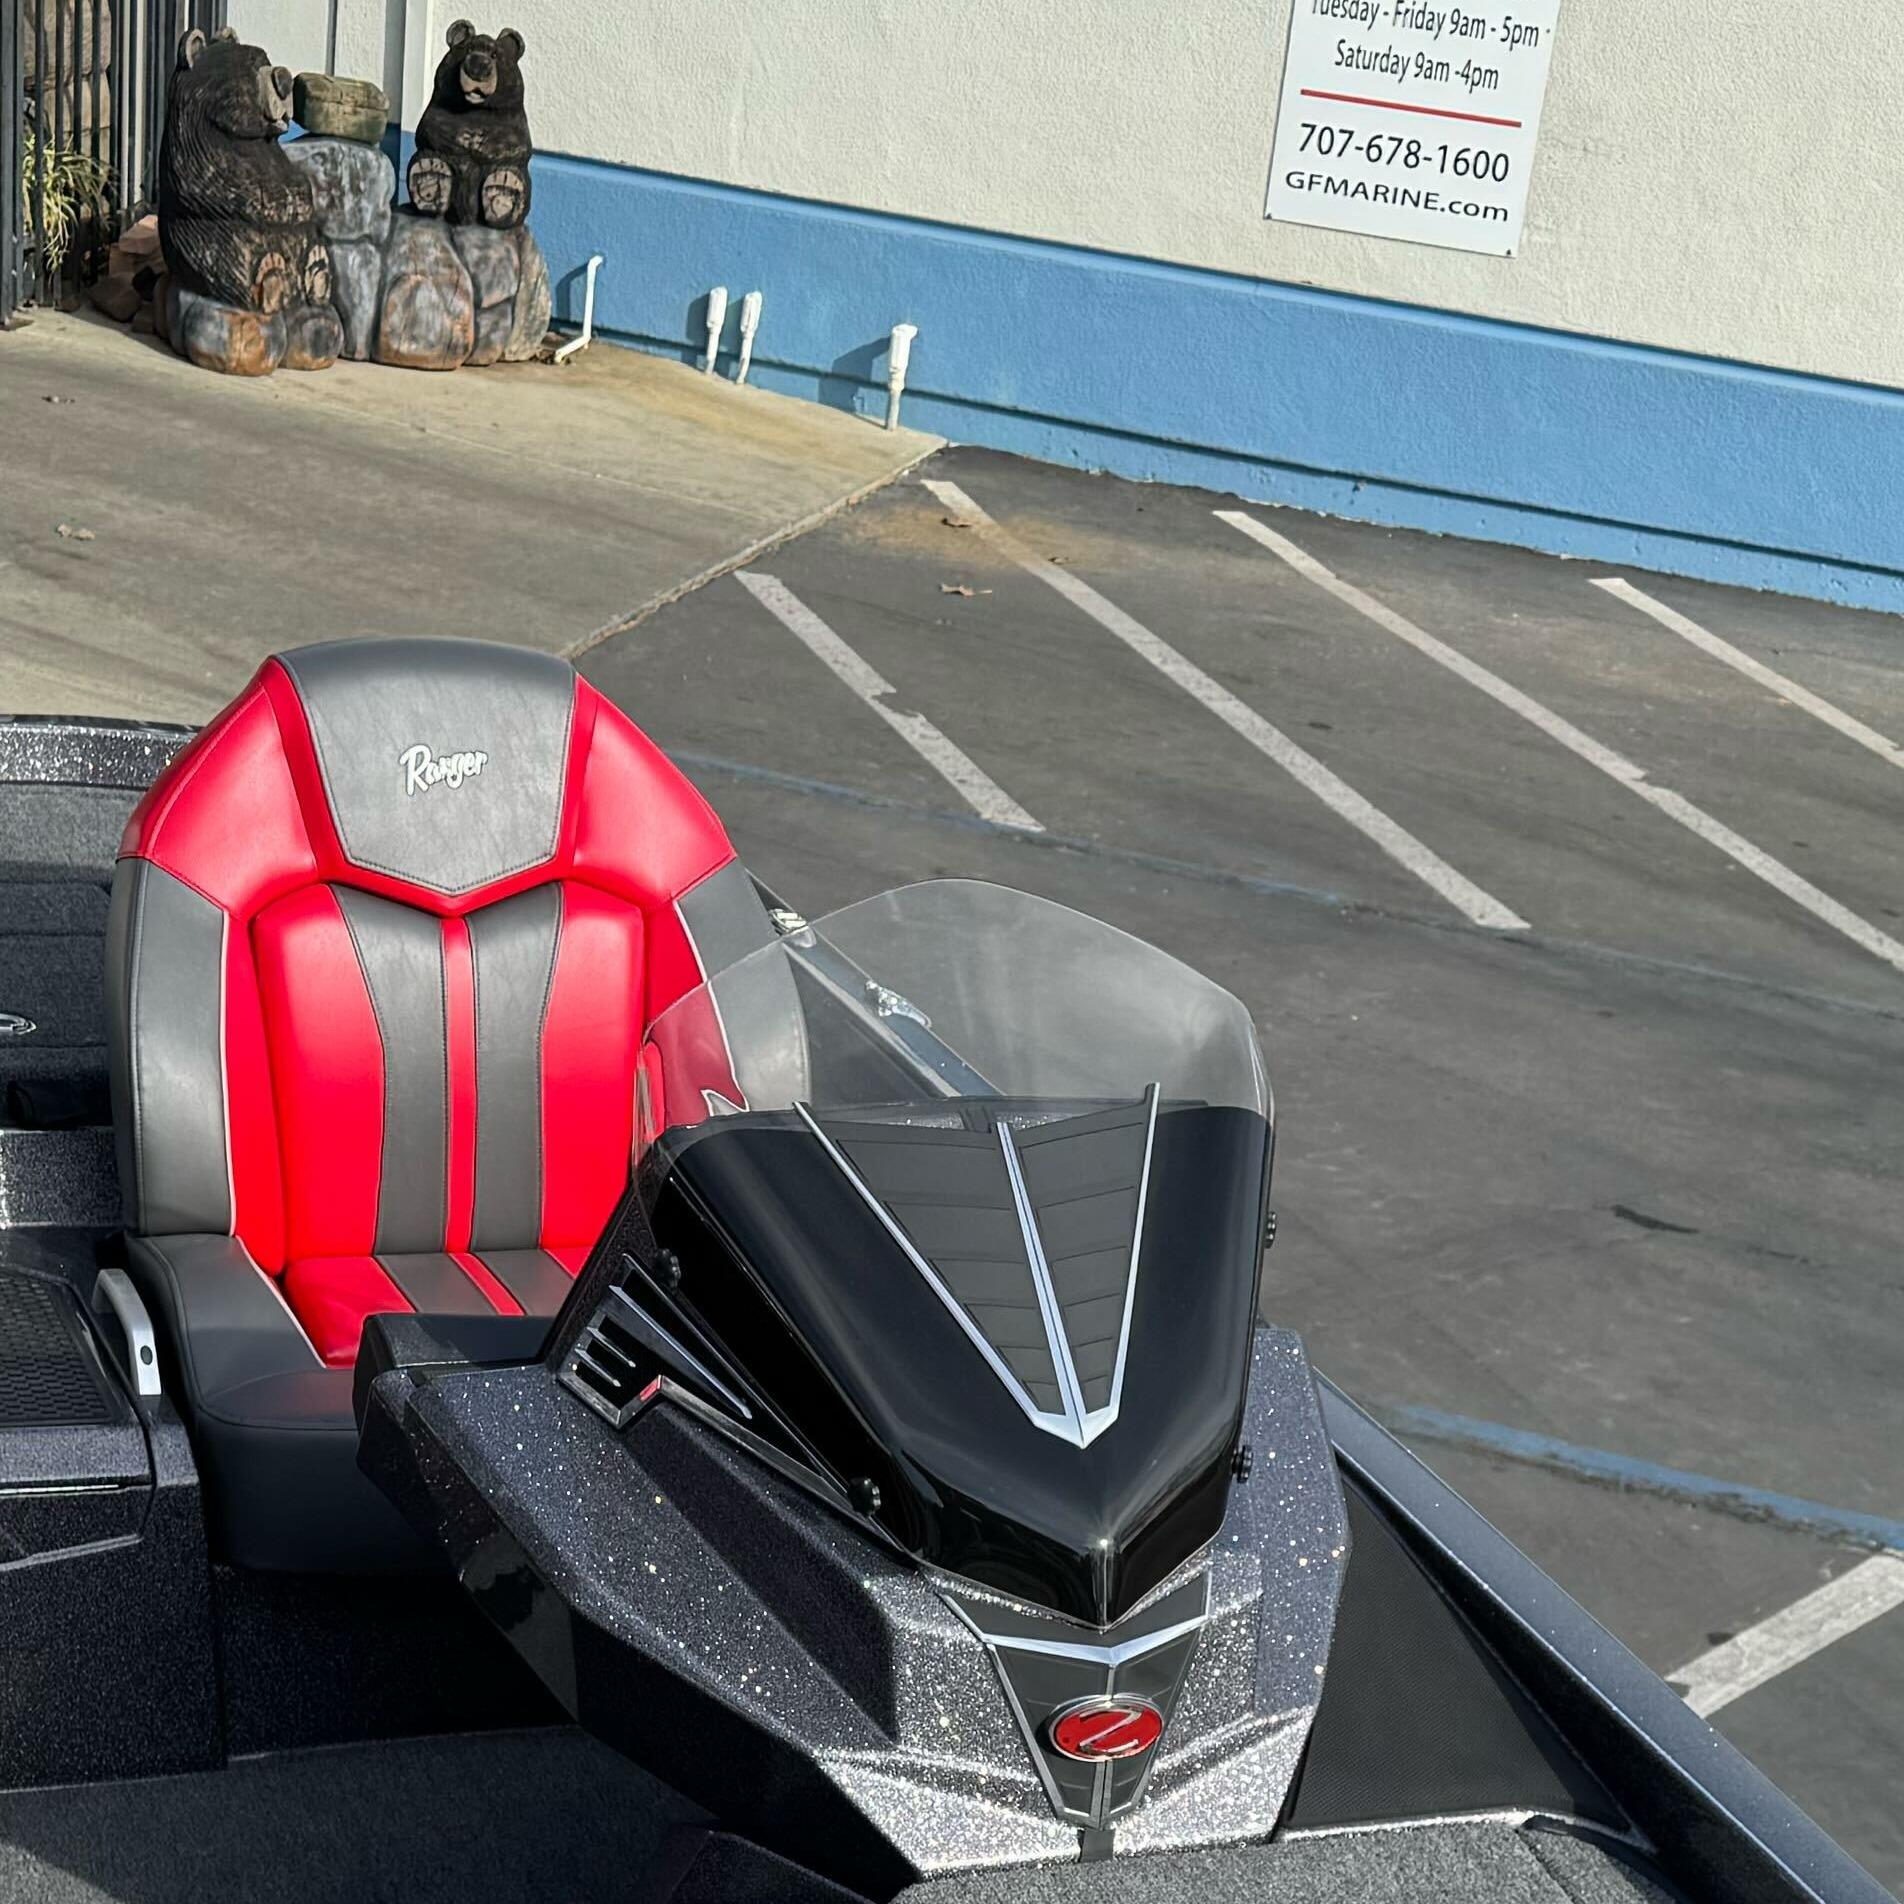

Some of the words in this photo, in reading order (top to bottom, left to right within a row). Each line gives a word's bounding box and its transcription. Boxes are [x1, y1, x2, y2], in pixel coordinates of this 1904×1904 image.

[1312, 0, 1380, 31] Tuesday
[1392, 2, 1446, 40] Friday
[1449, 8, 1486, 40] 9am
[1500, 15, 1540, 51] 5pm
[1334, 39, 1411, 84] Saturday
[1413, 52, 1450, 83] 9am
[1299, 122, 1510, 183] 707-678-1600
[1285, 170, 1509, 222] GFMARINE.com
[399, 744, 488, 797] Ranger
